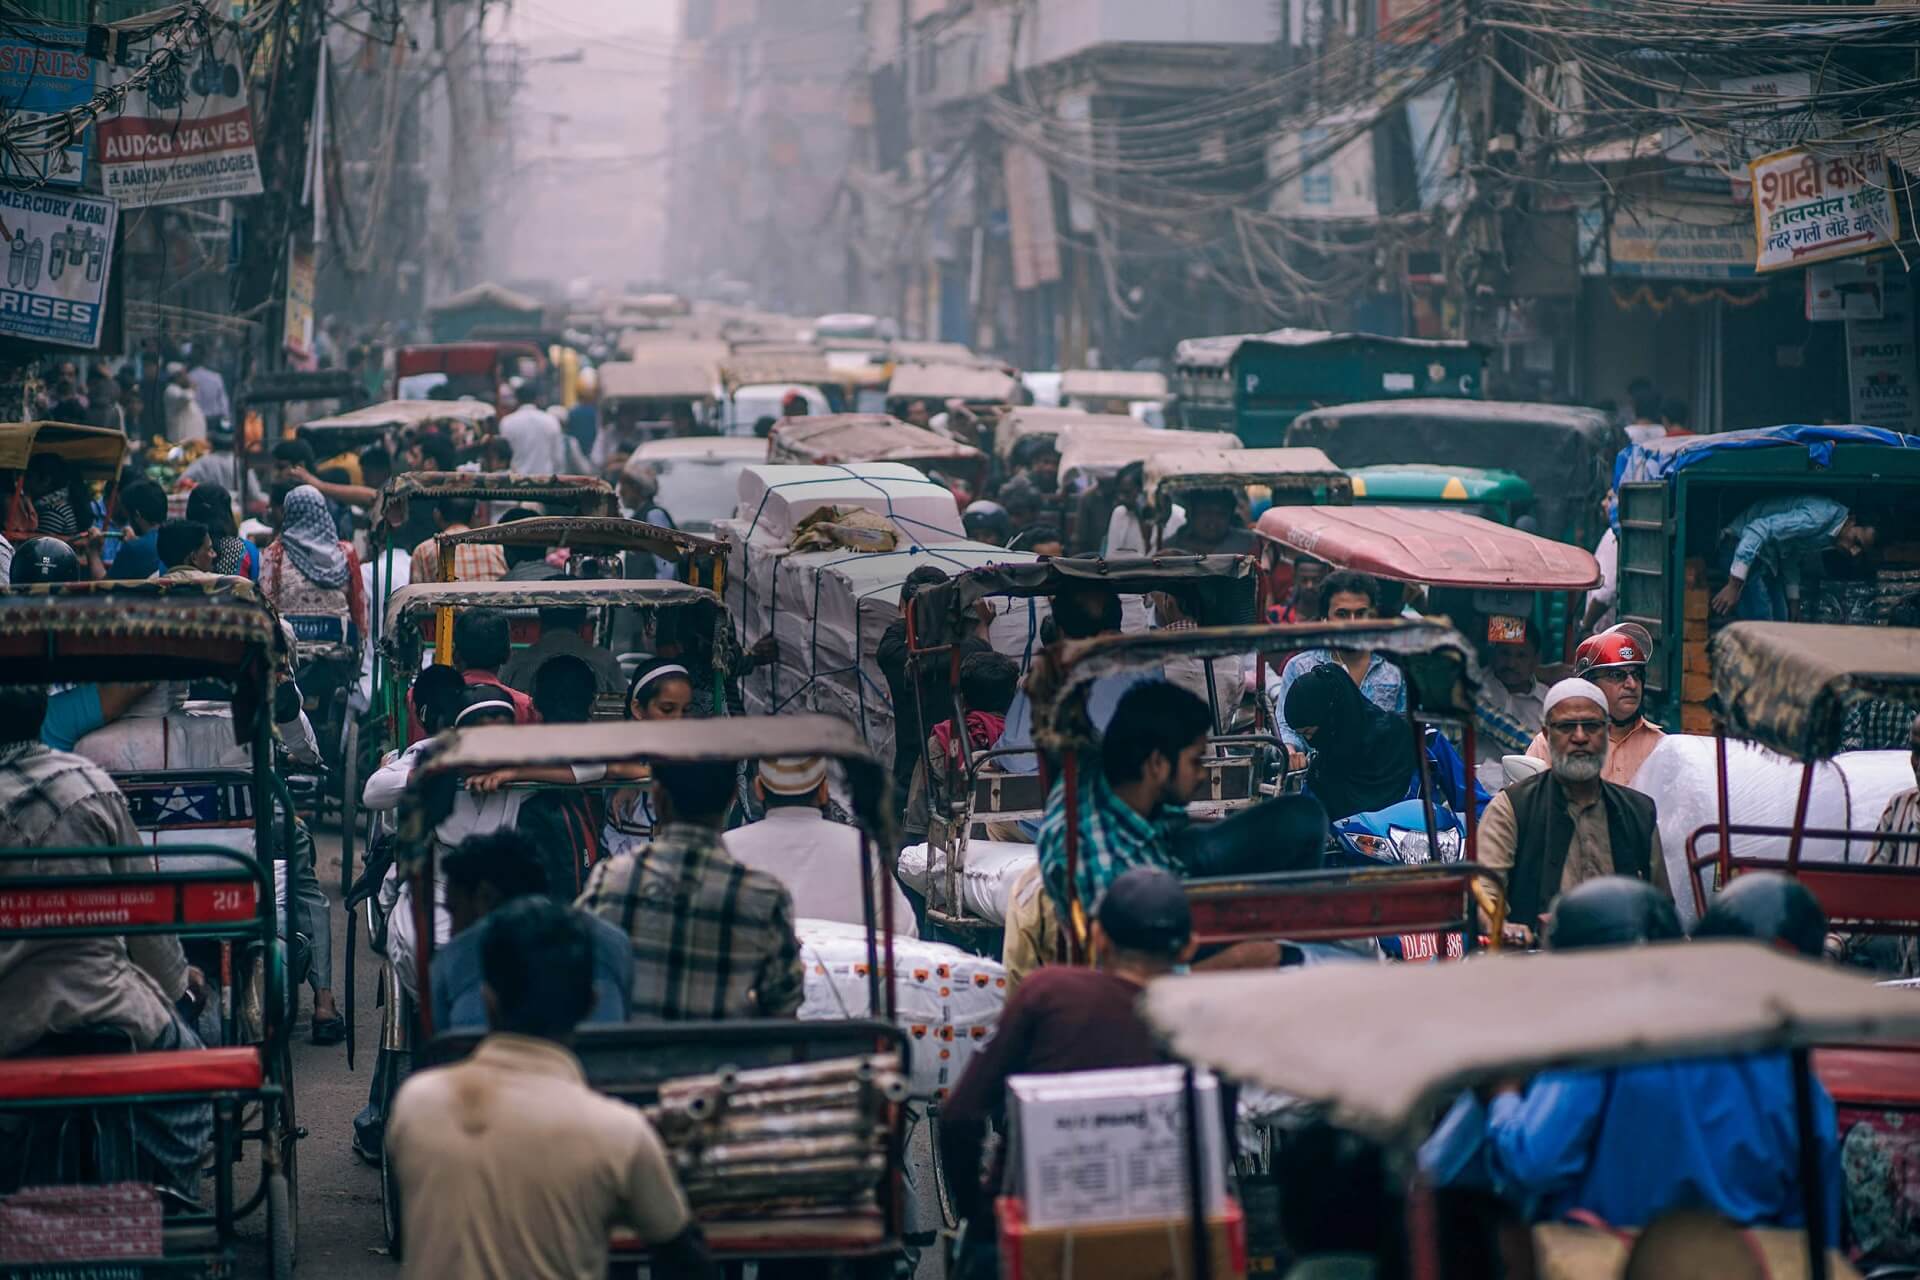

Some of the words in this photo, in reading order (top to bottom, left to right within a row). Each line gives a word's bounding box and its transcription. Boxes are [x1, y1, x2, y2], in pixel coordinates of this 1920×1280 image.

[0, 46, 90, 80] STRIES
[105, 133, 171, 158] AUDCO
[176, 120, 250, 150] VALVES
[123, 165, 166, 186] AARYAN
[171, 154, 254, 181] TECHNOLOGIES
[1761, 156, 1822, 211] शादी
[0, 191, 70, 217] MERCURY
[72, 202, 106, 225] AKARI
[1795, 221, 1822, 243] गली
[0, 292, 91, 323] RISES
